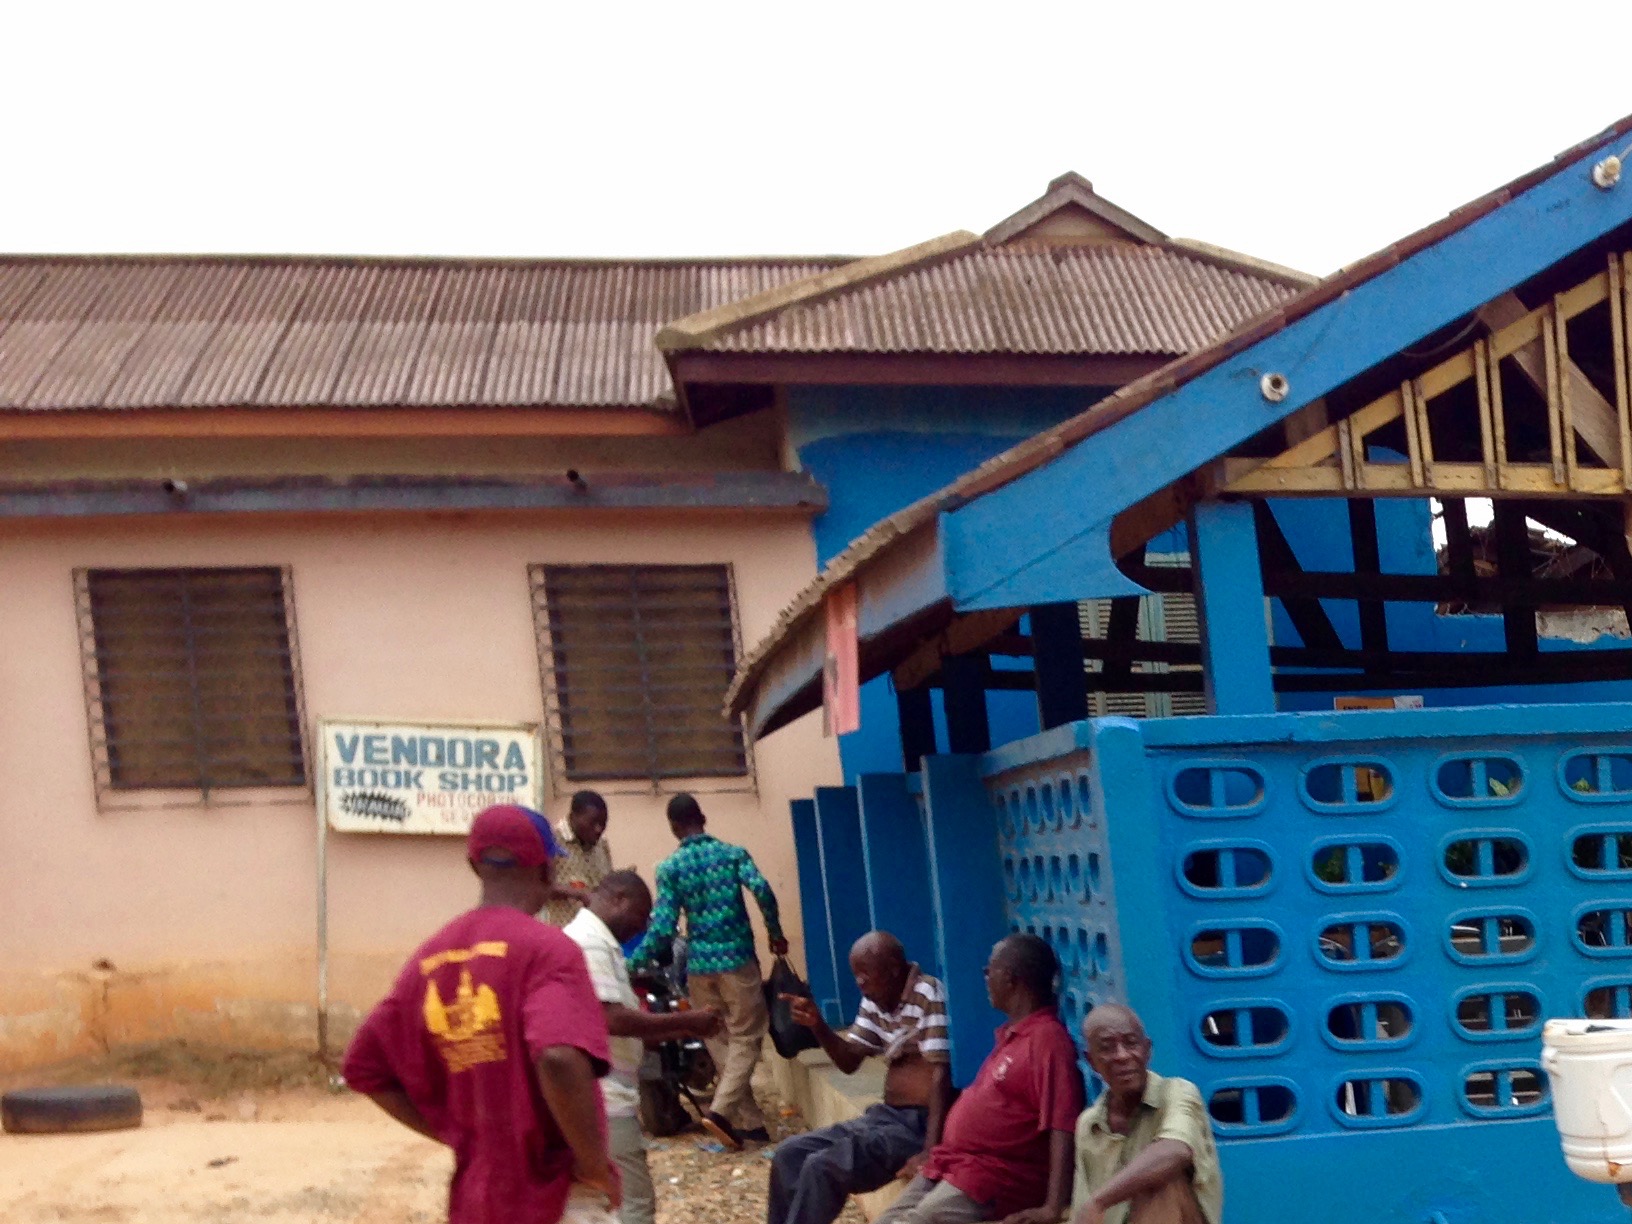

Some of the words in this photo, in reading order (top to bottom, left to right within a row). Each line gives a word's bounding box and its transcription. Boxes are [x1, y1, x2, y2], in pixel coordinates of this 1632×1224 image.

[335, 732, 527, 771] VENDORA
[334, 768, 424, 789] BOOK
[438, 771, 528, 793] SHOP
